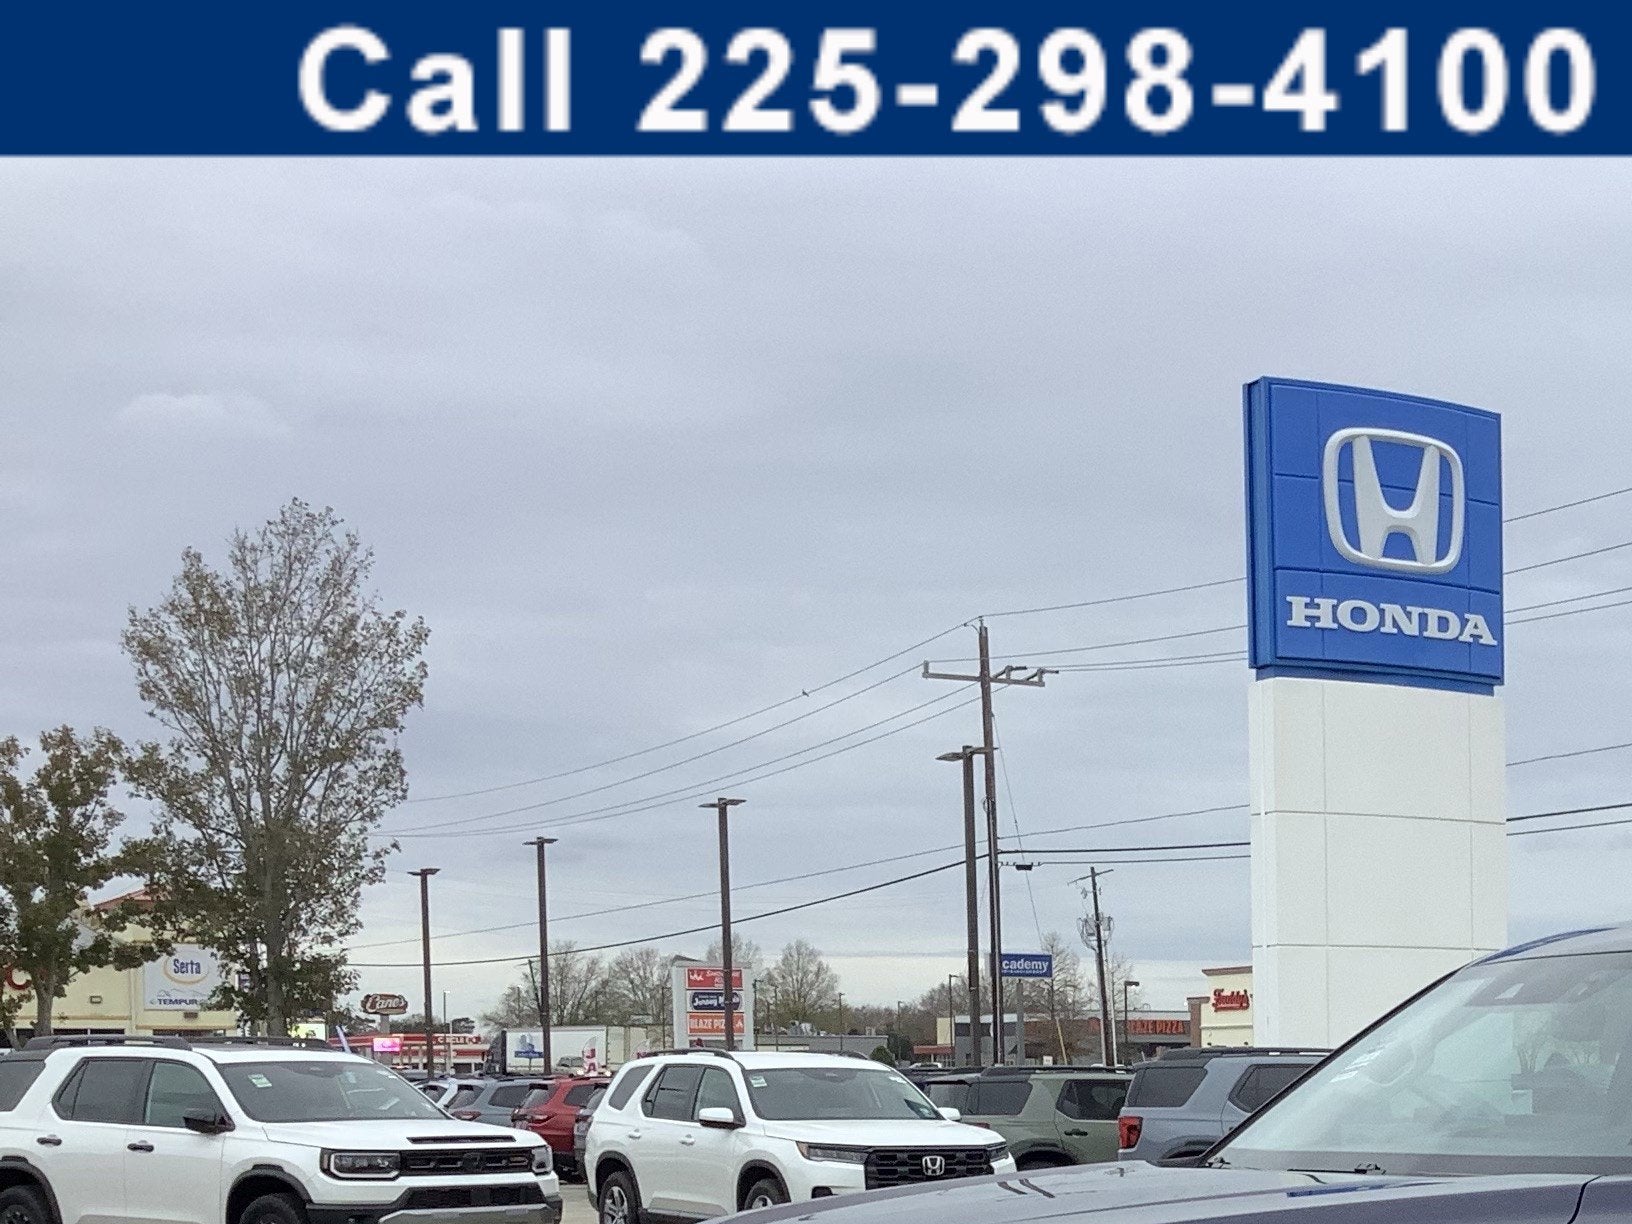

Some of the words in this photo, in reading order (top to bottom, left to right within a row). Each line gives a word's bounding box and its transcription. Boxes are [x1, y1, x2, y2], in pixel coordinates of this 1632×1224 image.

[1286, 596, 1497, 646] HONDA
[173, 958, 201, 974] Serta
[1001, 958, 1049, 973] cademy
